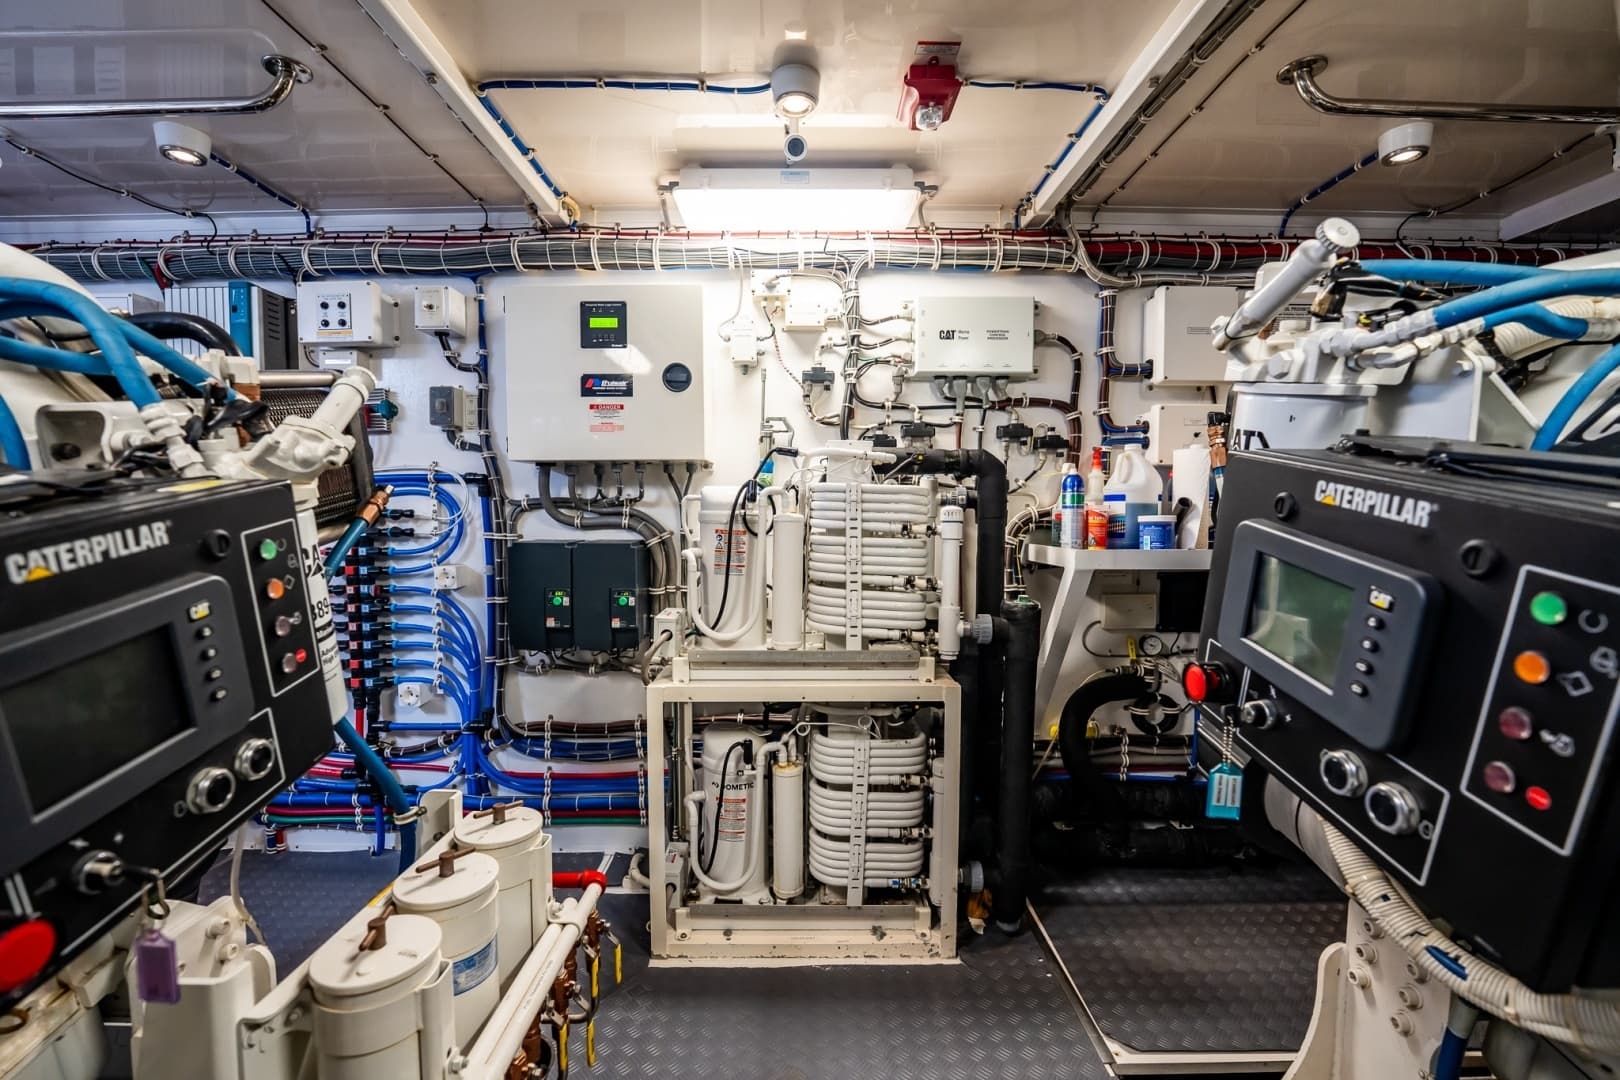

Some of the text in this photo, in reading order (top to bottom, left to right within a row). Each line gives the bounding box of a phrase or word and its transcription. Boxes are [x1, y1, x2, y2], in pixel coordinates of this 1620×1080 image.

[939, 329, 957, 340] CAT
[1314, 479, 1432, 529] CATERPILLAR
[4, 519, 172, 585] CATERPILLAR
[722, 781, 755, 791] OMETIC
